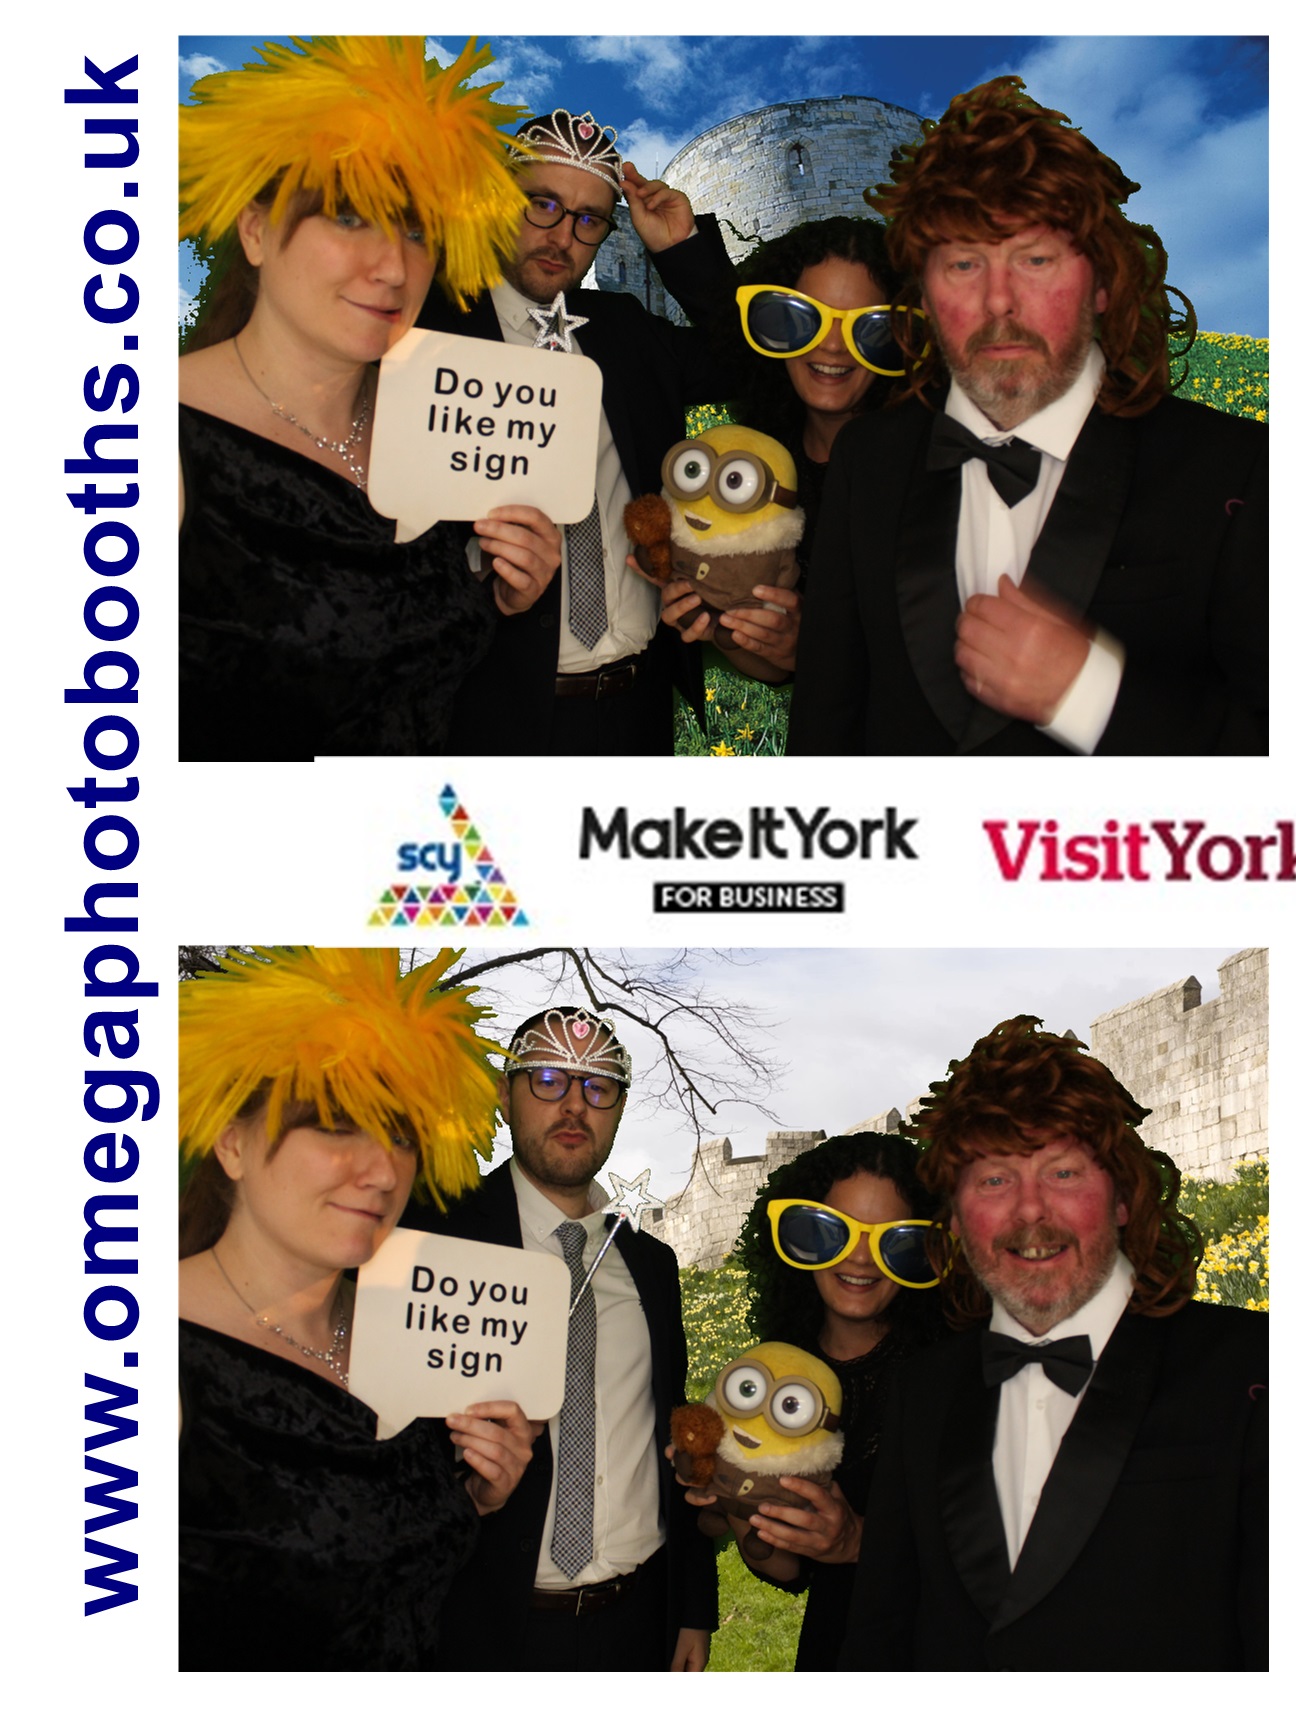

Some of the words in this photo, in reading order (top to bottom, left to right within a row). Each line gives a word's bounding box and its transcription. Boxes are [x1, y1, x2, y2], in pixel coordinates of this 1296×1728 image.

[434, 367, 484, 399] Do
[492, 381, 557, 409] you
[428, 403, 496, 437] like
[507, 419, 557, 449] my
[450, 445, 529, 481] sign
[411, 1265, 459, 1297] Do
[467, 1279, 528, 1307] you
[405, 1301, 471, 1335] like
[481, 1316, 528, 1346] my
[427, 1343, 503, 1378] sign
